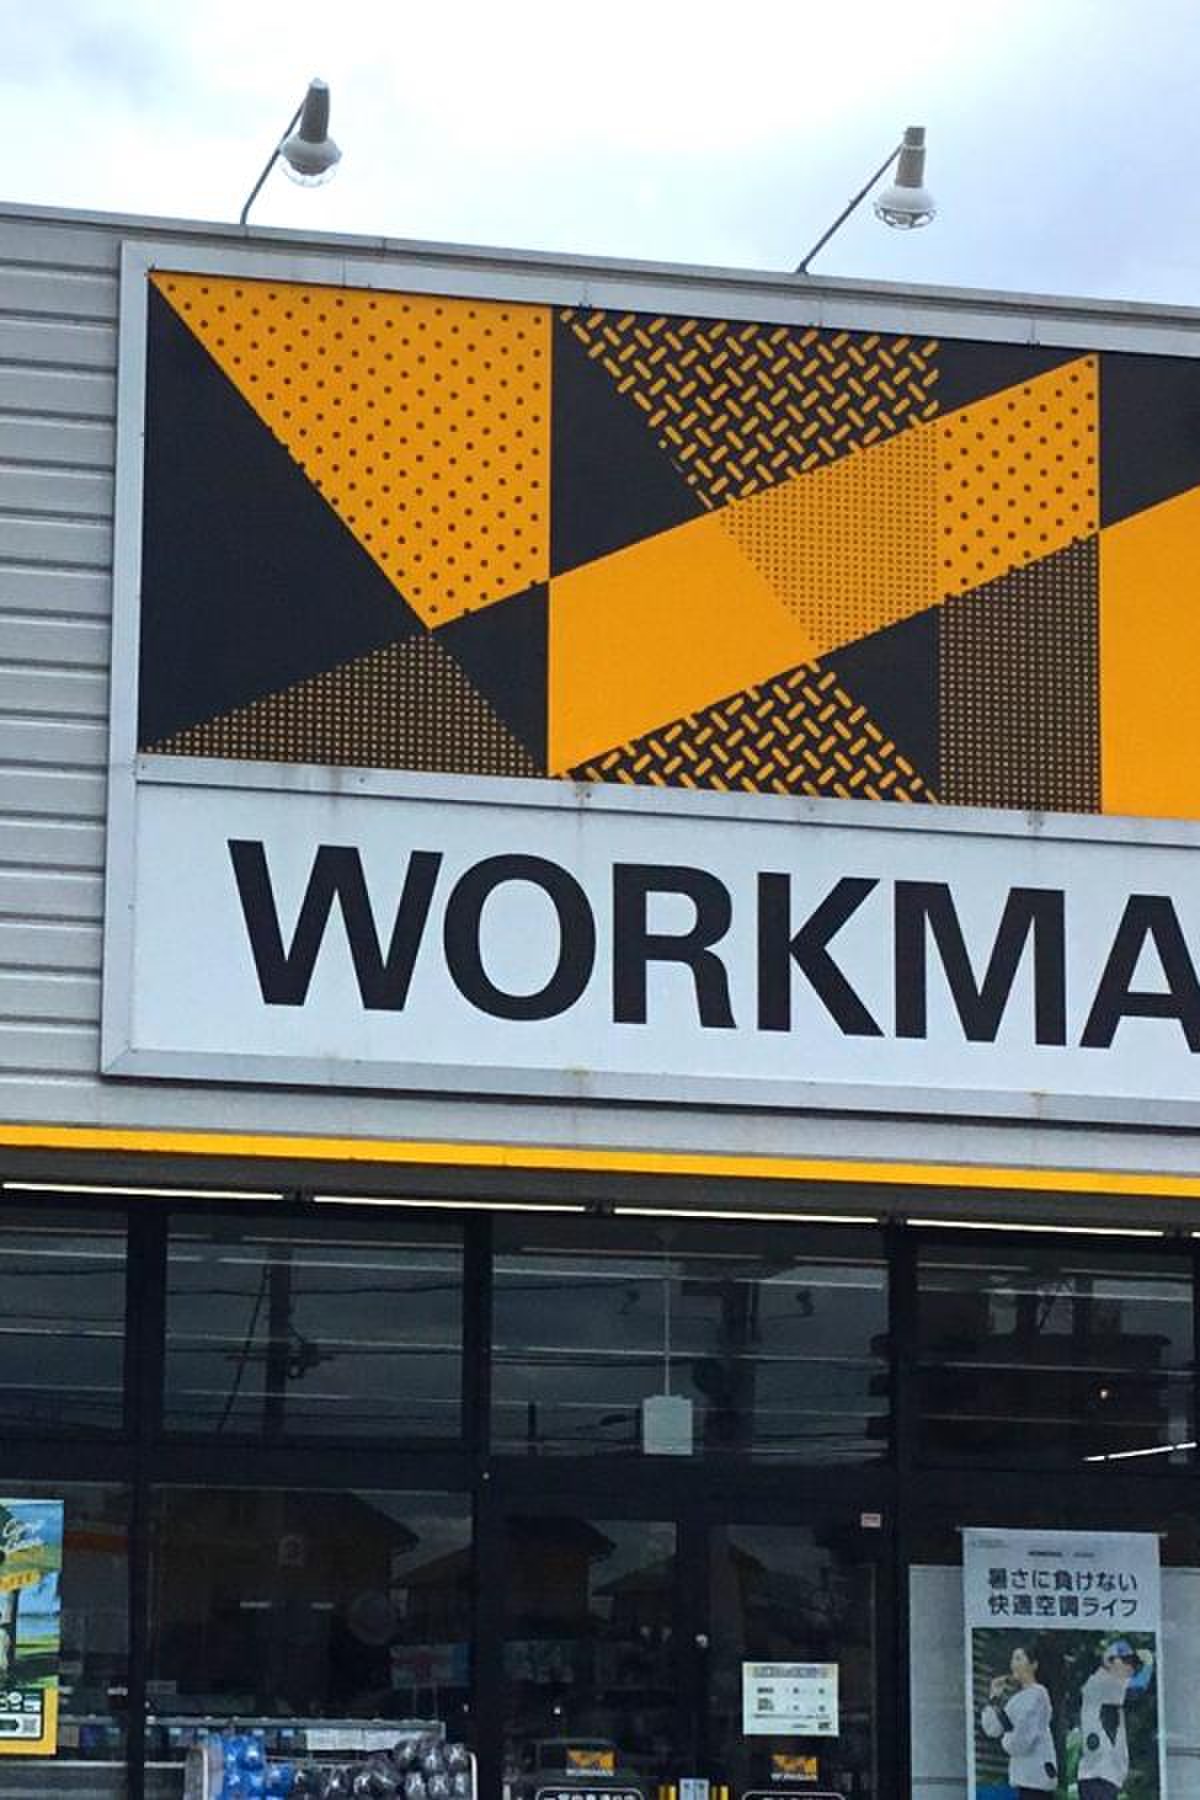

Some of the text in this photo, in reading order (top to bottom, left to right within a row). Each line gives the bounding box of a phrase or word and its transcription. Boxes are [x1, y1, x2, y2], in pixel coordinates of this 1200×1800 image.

[988, 1568, 1137, 1592] 暑さに負けない
[988, 1594, 1138, 1617] 快適空調ライフ
